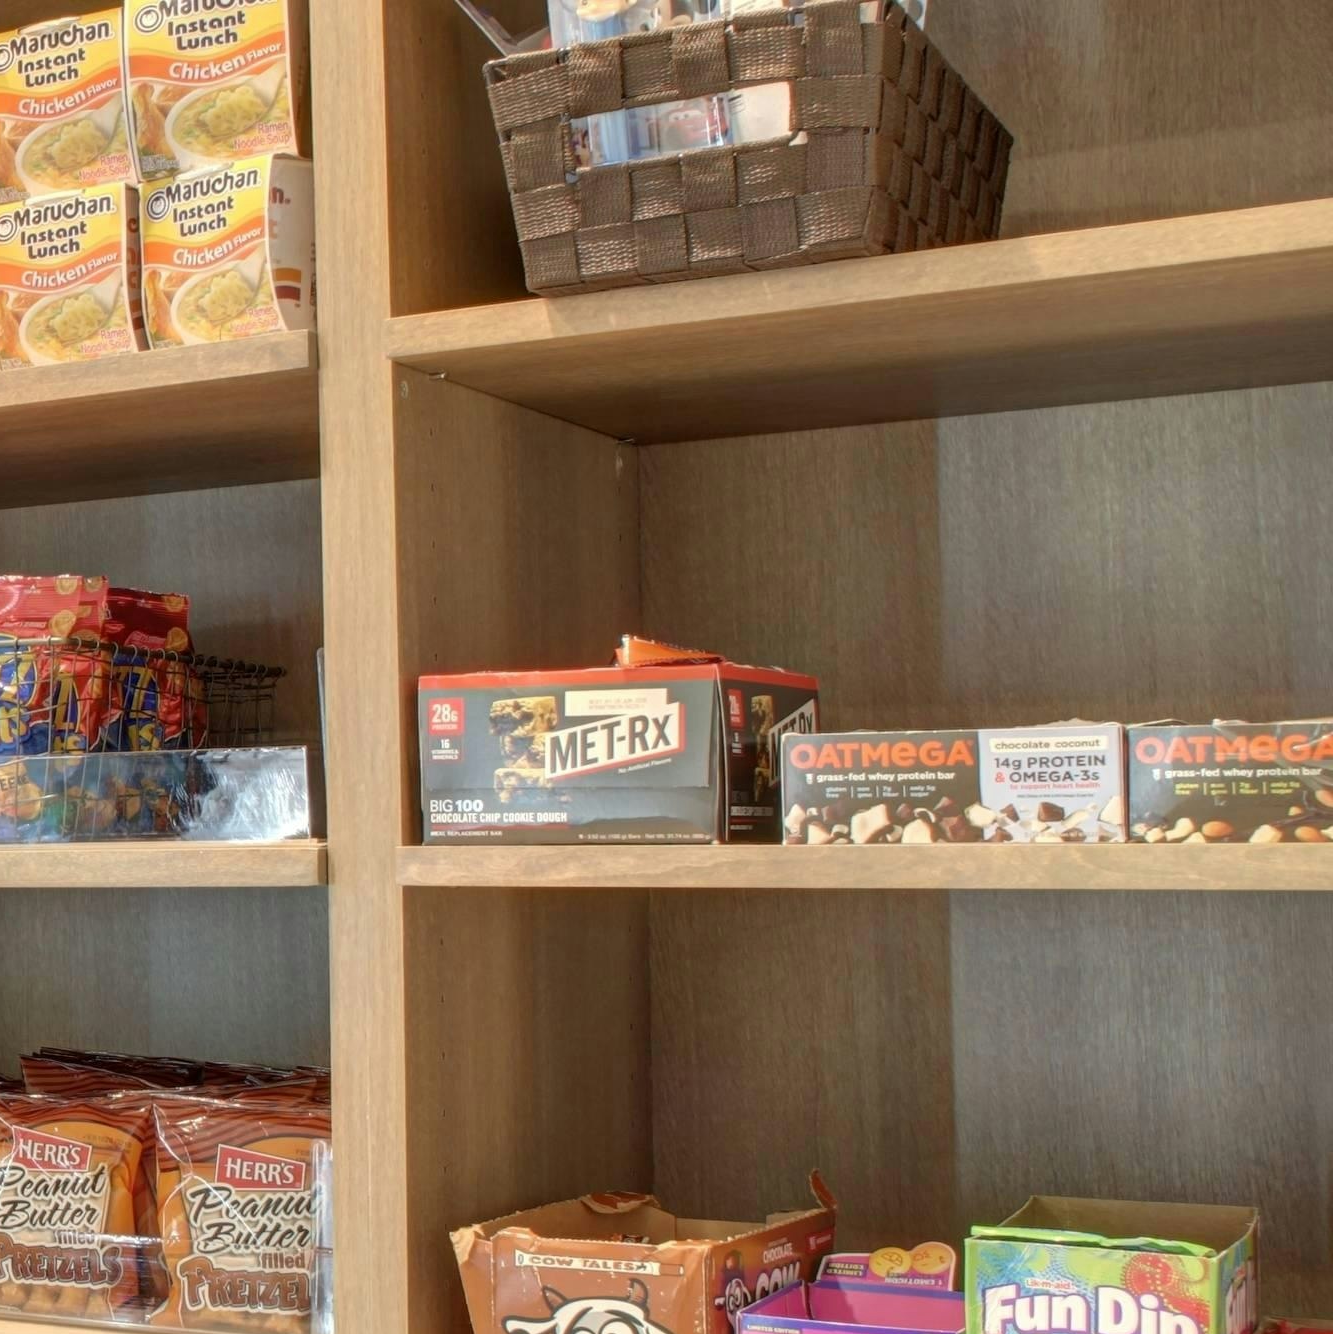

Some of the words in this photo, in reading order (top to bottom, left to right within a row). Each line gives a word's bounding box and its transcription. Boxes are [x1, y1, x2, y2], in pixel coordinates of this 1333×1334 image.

[167, 10, 246, 36] Instant
[9, 21, 110, 56] Maruchan
[176, 29, 239, 52] Lunch
[17, 49, 86, 74] Instant
[169, 53, 246, 81] Chicken
[246, 42, 283, 62] Flavor
[24, 66, 79, 88] Lunch
[18, 90, 86, 116] Chicken
[87, 77, 118, 98] Flavor
[165, 169, 259, 201] Maruchan
[14, 196, 113, 227] Maruchan
[173, 196, 234, 223] Instant
[179, 216, 227, 238] Lunch
[21, 264, 86, 289] Chicken
[549, 712, 674, 775] MET-RX
[995, 740, 1050, 750] chocolate
[1055, 740, 1100, 748] coconut
[994, 758, 1021, 770] 14g
[1027, 755, 1106, 768] PROTEIN
[817, 772, 865, 783] grass-fed
[868, 772, 894, 782] whey
[897, 771, 936, 781] protein
[938, 771, 955, 780] bar
[994, 772, 1005, 783] &
[1009, 770, 1100, 783] OMEGA-3s
[430, 800, 453, 812] BIG
[455, 800, 483, 812] 100
[431, 812, 477, 823] CHOCOLATE
[480, 812, 501, 823] CHIP
[503, 812, 534, 822] COOKIE
[537, 812, 567, 822] DOUGH
[18, 1139, 83, 1166] HERR'S
[225, 1157, 295, 1185] HERR'S
[196, 1223, 311, 1255] Butter
[260, 1251, 305, 1270] filled
[528, 1255, 575, 1268] COW
[582, 1259, 635, 1271] TALES
[763, 1243, 793, 1264] CHOCOLATE
